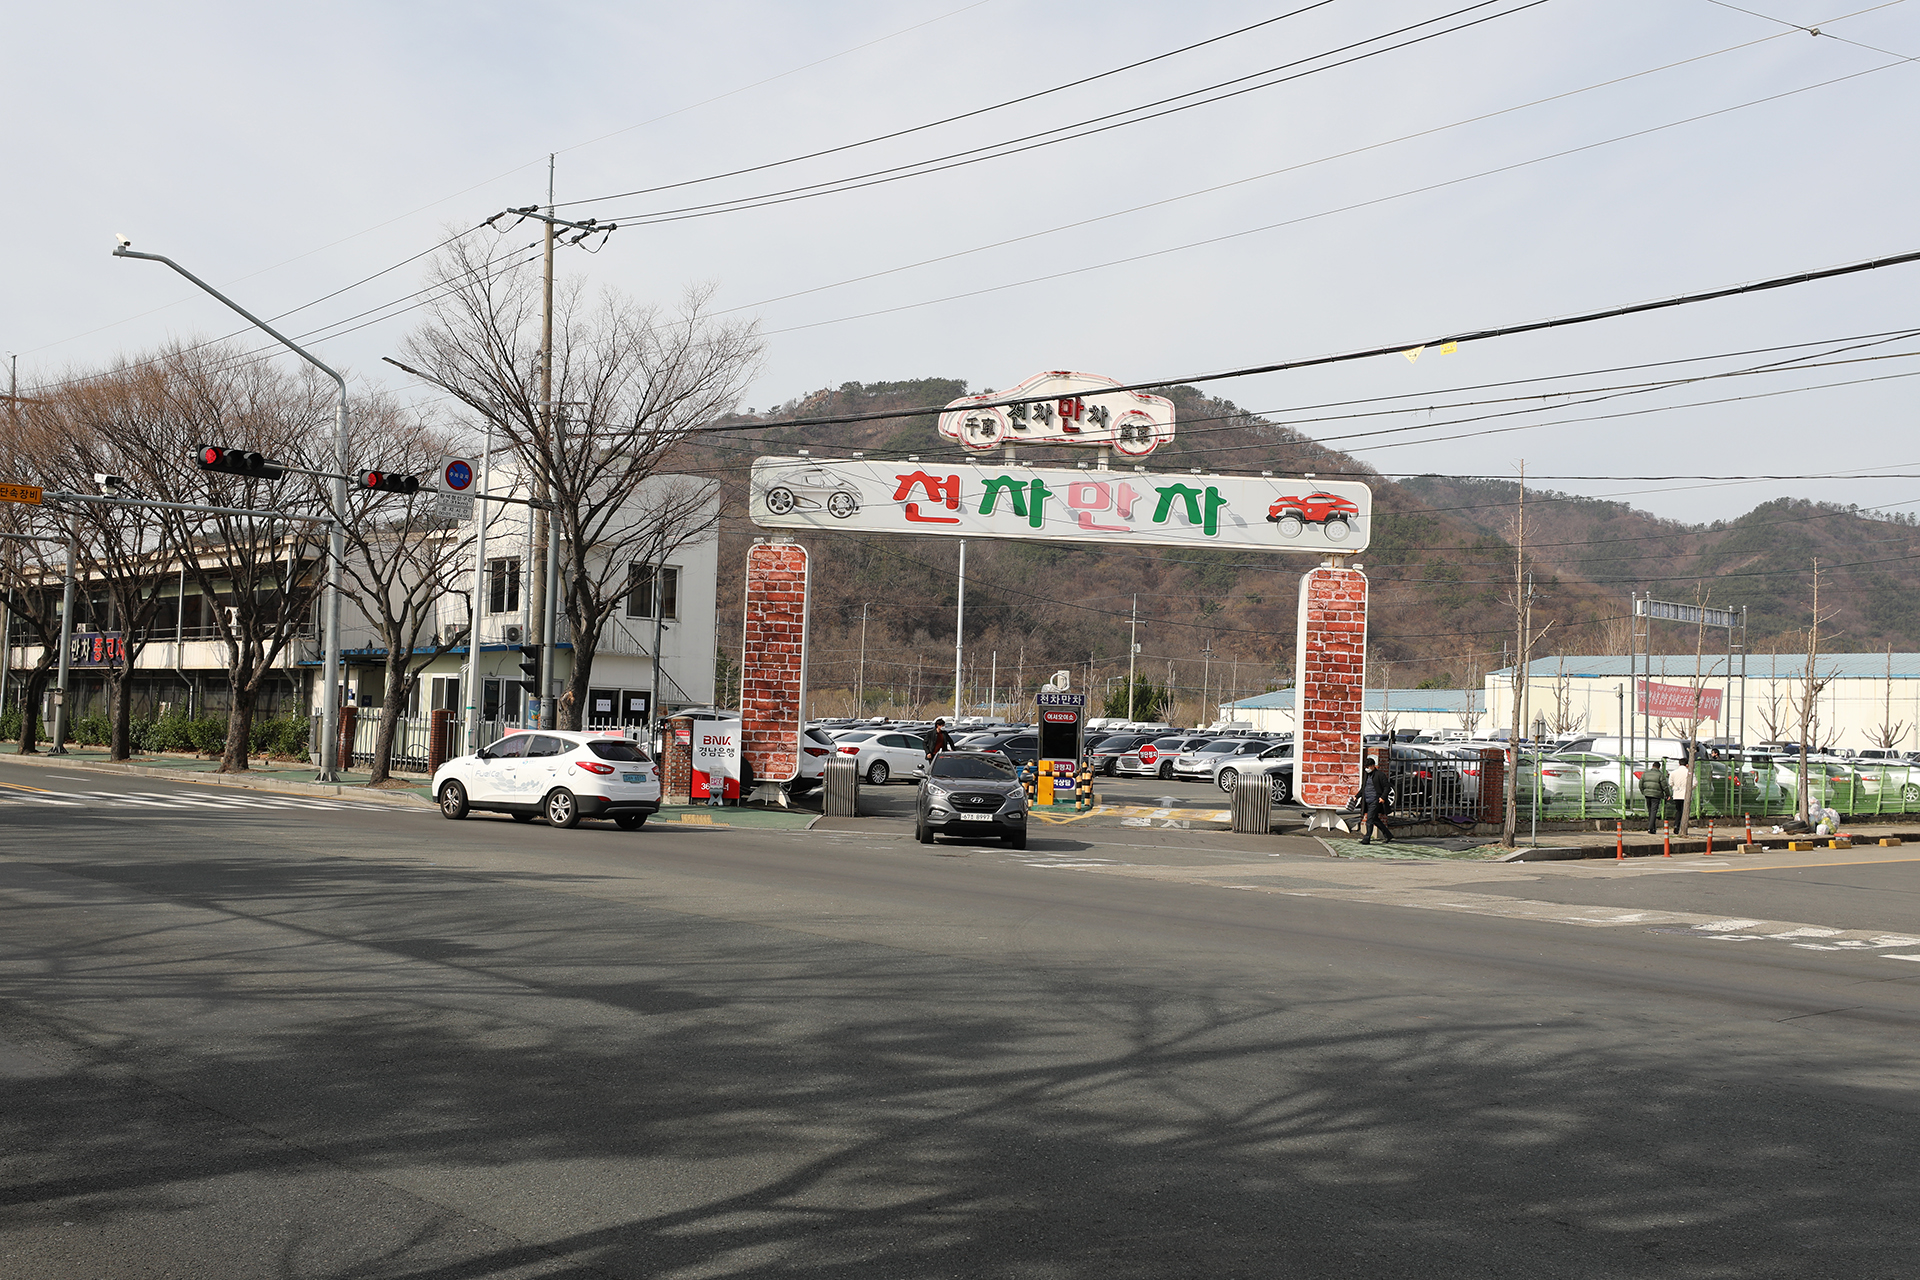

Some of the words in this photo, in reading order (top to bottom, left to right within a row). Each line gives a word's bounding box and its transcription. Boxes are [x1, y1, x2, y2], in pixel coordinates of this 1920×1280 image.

[1006, 396, 1109, 433] 천차만차
[0, 487, 38, 500] 단속장비
[892, 468, 1227, 537] 천차만차
[1040, 694, 1082, 705] 천차만차
[703, 735, 731, 746] BNK
[699, 746, 735, 758] 경남은행
[1054, 763, 1072, 771] 단정지
